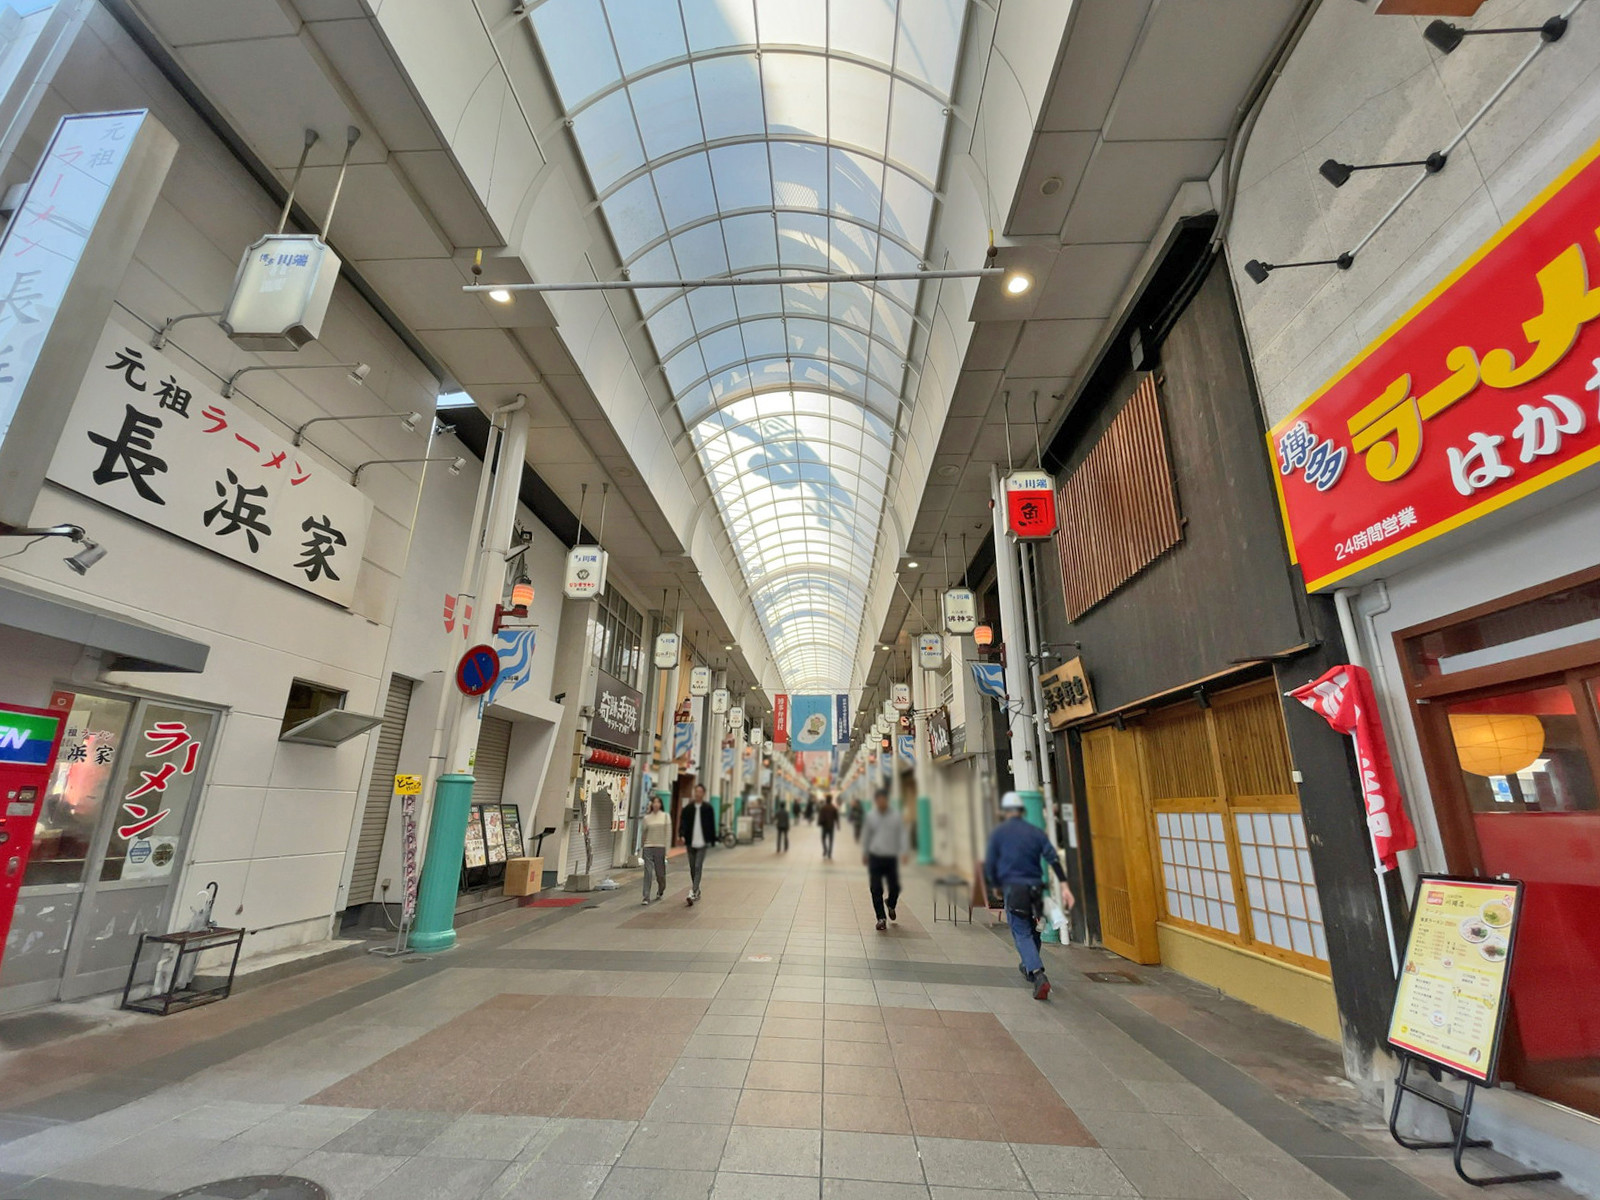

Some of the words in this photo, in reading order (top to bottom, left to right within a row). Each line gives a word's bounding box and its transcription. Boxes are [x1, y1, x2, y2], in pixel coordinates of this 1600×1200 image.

[86, 404, 347, 582] 長浜家
[1279, 420, 1348, 492] 博多
[1334, 505, 1418, 561] 24時間営業
[118, 721, 201, 840] ラーメン
